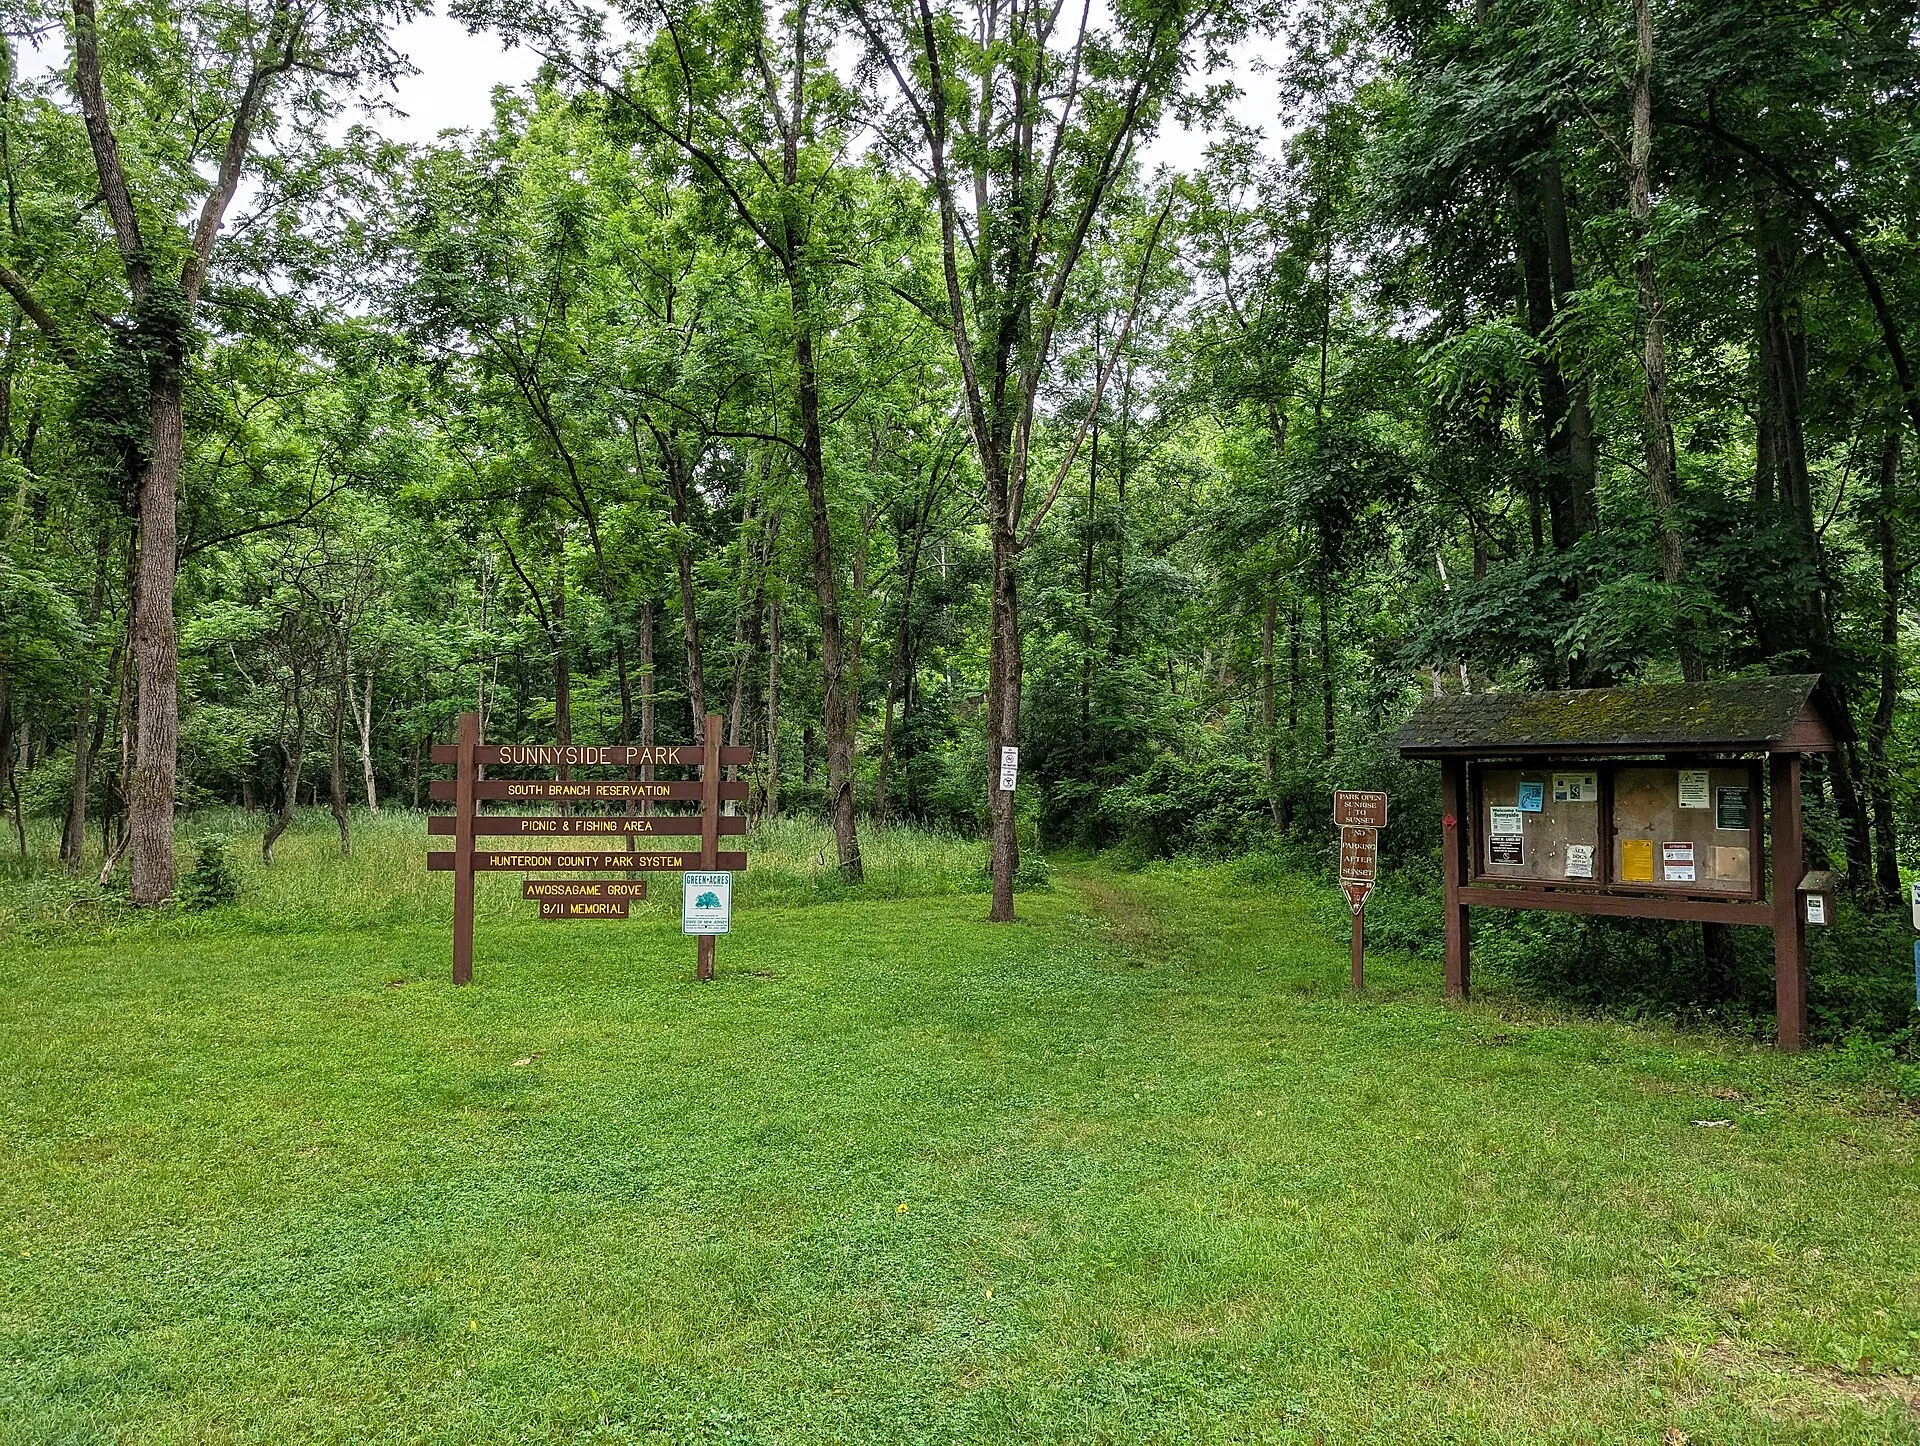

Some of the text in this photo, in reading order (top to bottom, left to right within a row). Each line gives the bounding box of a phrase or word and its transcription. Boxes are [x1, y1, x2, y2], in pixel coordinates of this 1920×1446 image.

[499, 746, 681, 765] SUNNYSIDE PARK
[508, 784, 670, 796] SOUTH BRANCH RESERVATION
[521, 820, 652, 831] PICNIC & FISHING AREA
[1342, 842, 1376, 850] PARKING
[490, 856, 682, 867] HUNTERDON COUNTY PARK SYSTEM
[1342, 868, 1374, 876] SUNSET
[686, 875, 728, 884] GREEN ACRES
[526, 884, 642, 896] AWOSSAGAME GROVE
[542, 903, 624, 914] 9/11 MEMORIAL
